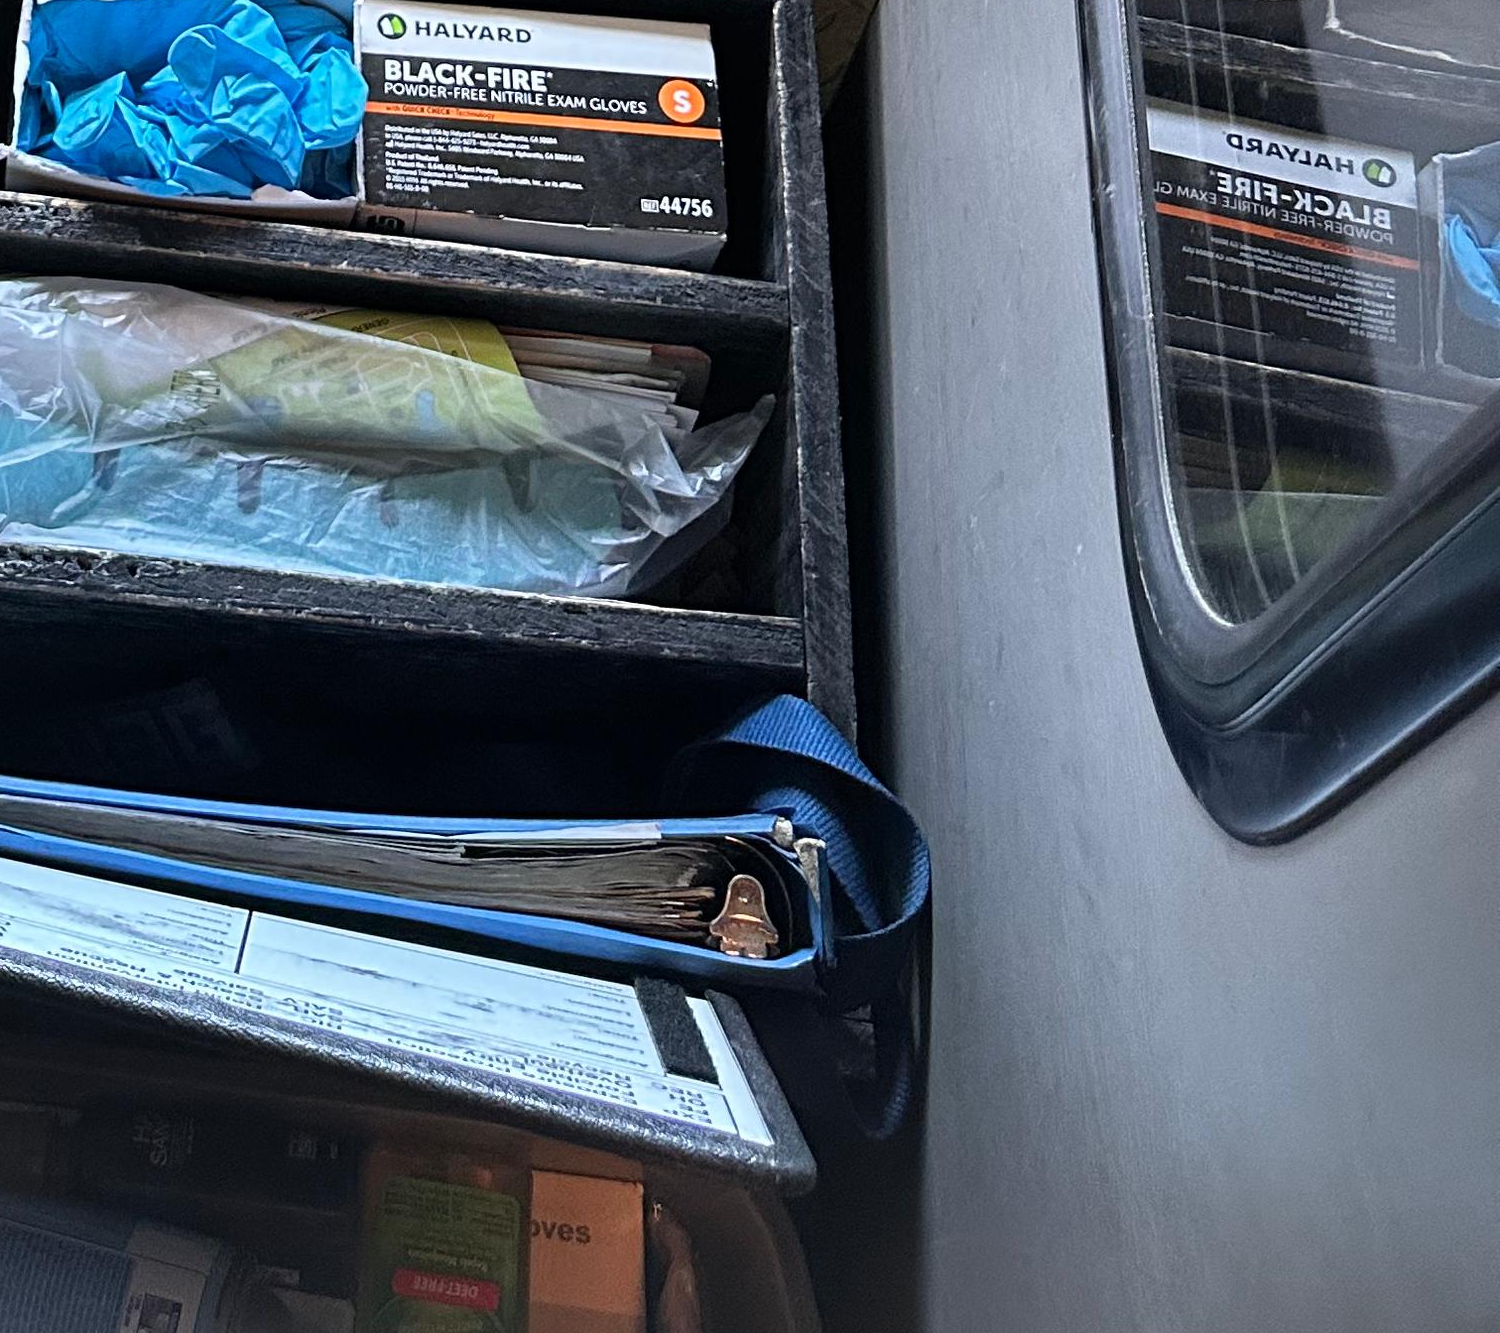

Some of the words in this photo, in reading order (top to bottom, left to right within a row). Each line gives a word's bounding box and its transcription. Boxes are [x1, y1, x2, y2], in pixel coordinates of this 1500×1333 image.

[415, 20, 532, 43] HALYARD
[384, 83, 486, 102] POWDER-FREE
[490, 87, 544, 106] NITRILE
[547, 93, 586, 109] EXAM
[590, 97, 647, 114] GLOVES
[672, 90, 691, 114] S
[659, 196, 713, 217] 44756
[172, 969, 264, 996] Salvage
[182, 978, 263, 1003] Search
[522, 1057, 632, 1089] Overhaul
[413, 1275, 478, 1299] DEET-FREE
